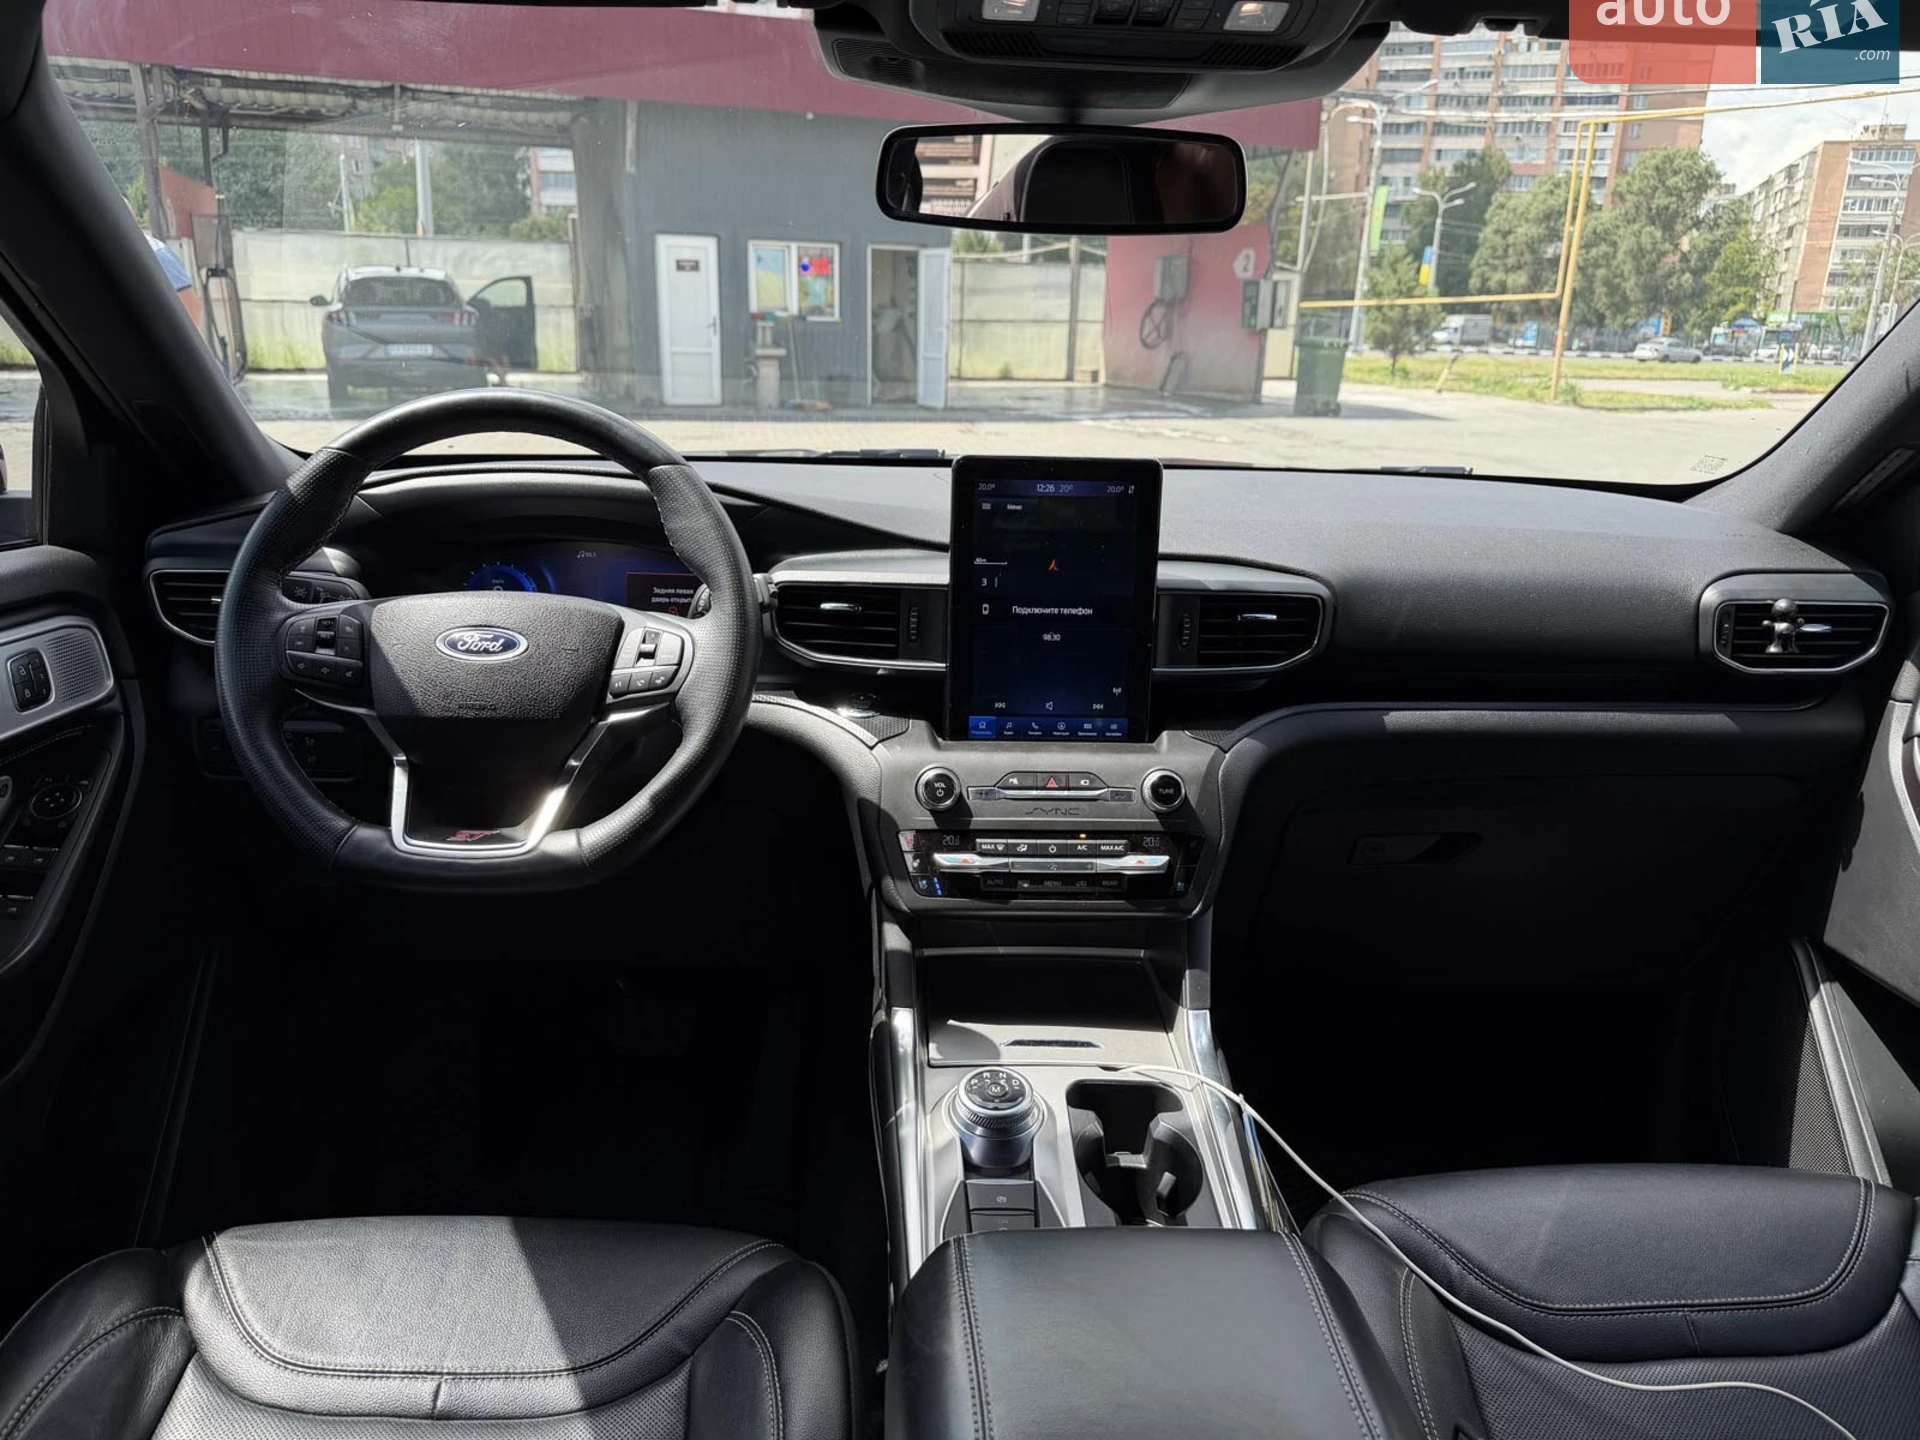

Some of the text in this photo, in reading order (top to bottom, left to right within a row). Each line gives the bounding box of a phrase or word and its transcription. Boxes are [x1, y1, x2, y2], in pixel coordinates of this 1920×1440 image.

[1036, 484, 1055, 493] 12:26
[981, 578, 988, 587] 3
[1012, 605, 1093, 616] Подключите телефон
[457, 633, 506, 652] Ford
[1025, 806, 1080, 816] SYNC
